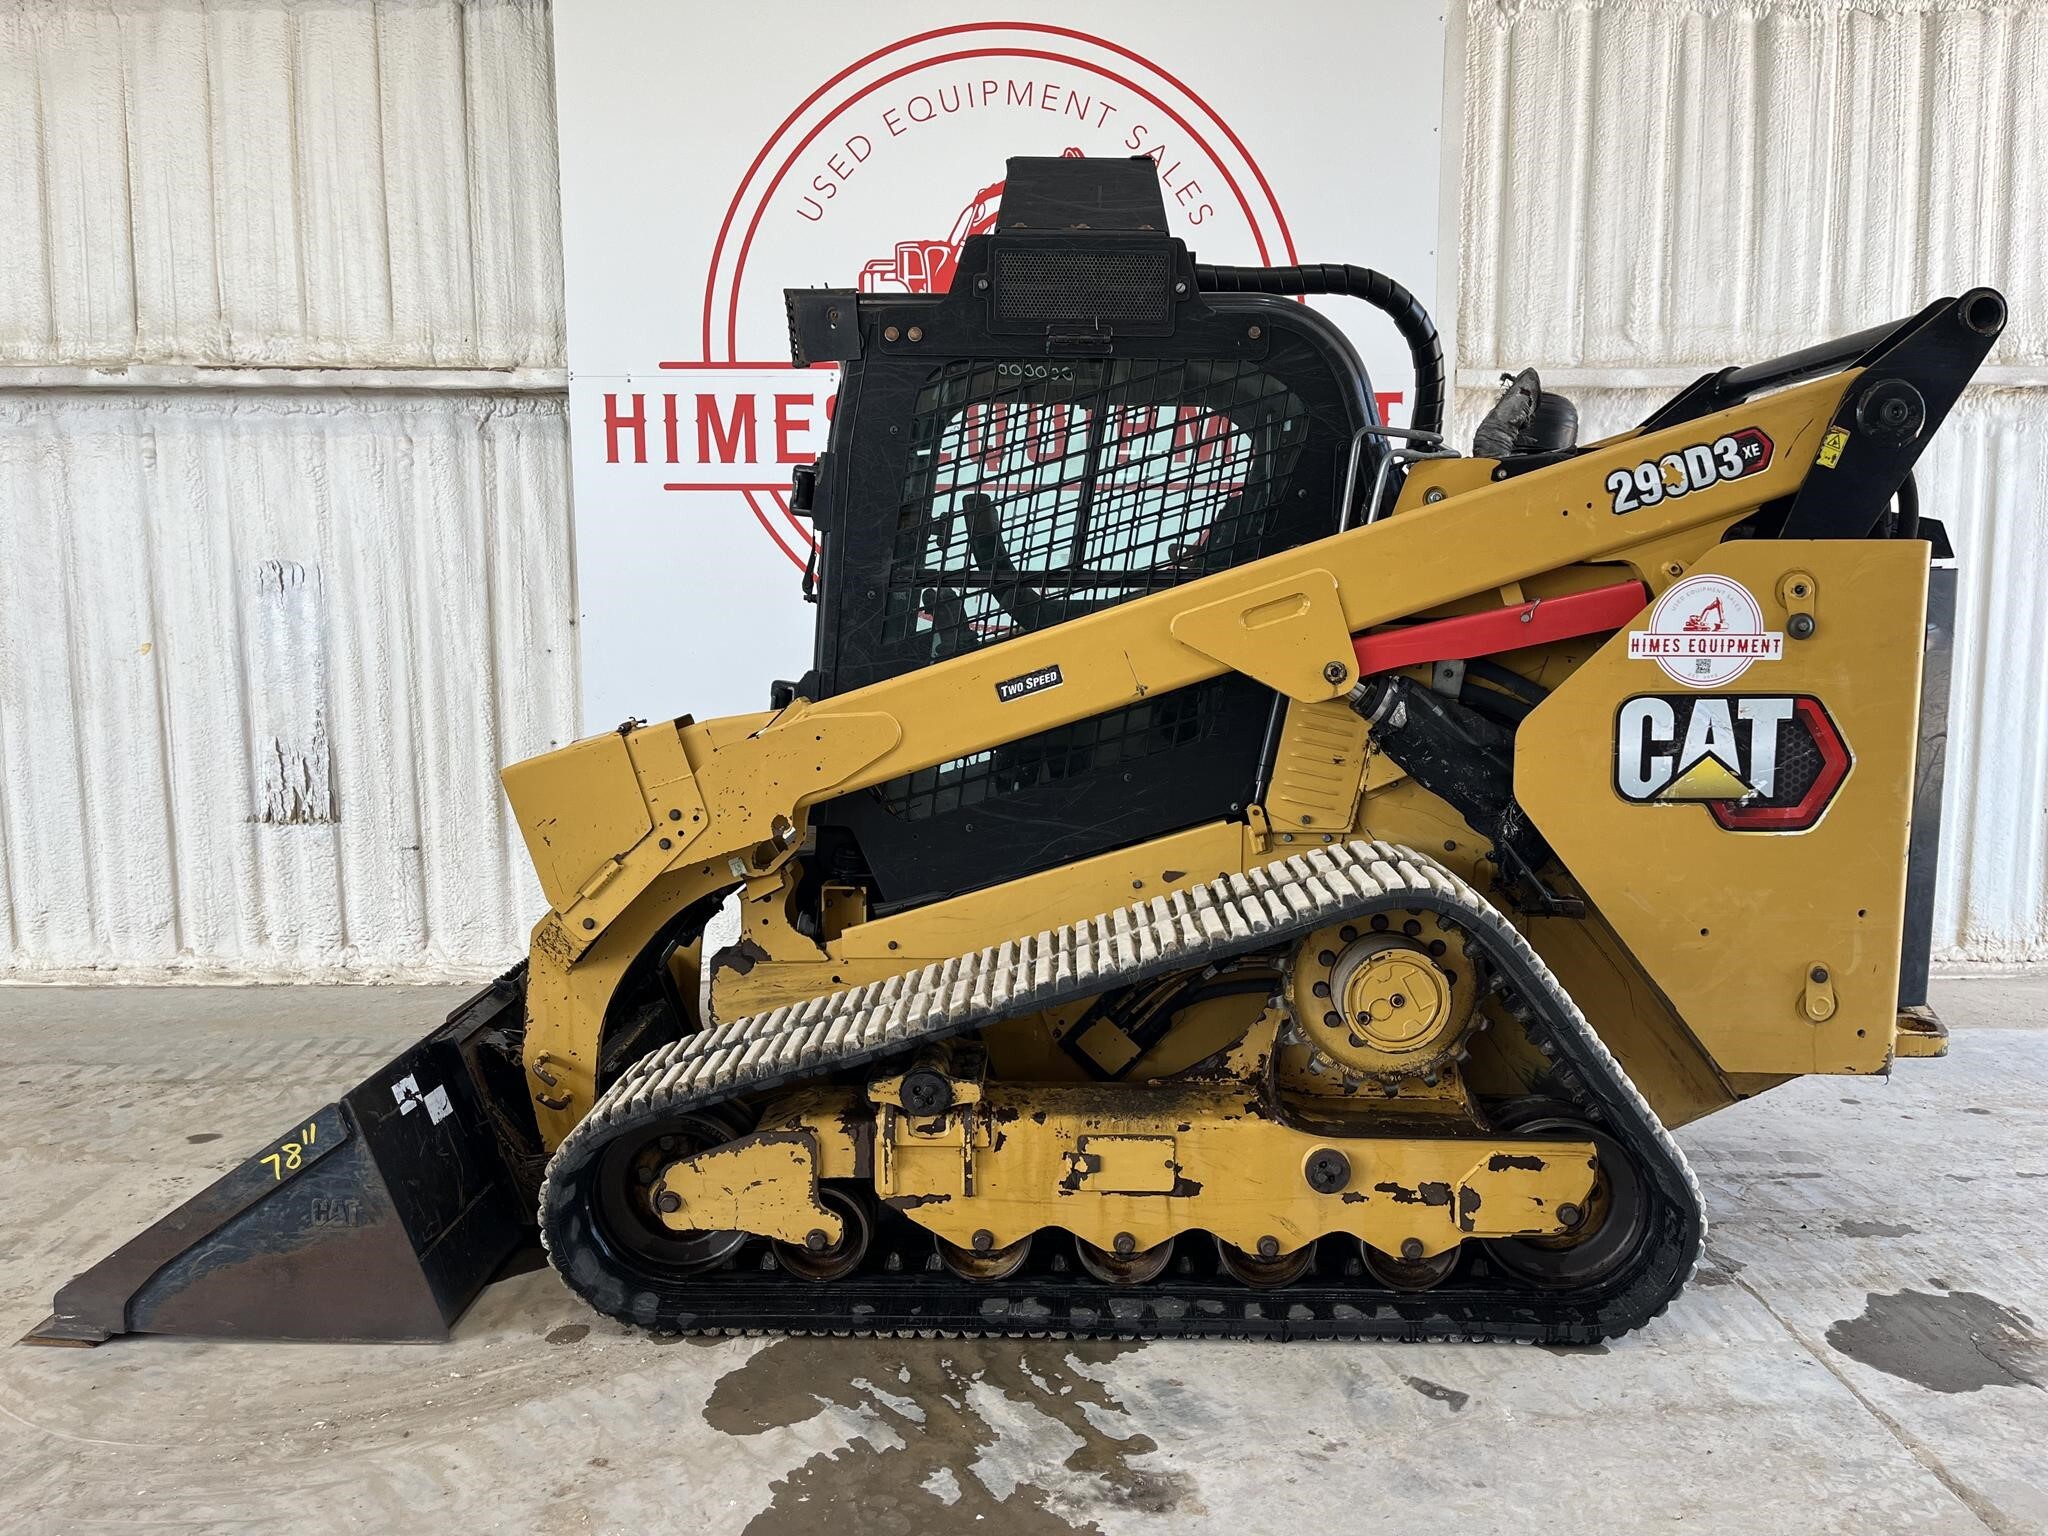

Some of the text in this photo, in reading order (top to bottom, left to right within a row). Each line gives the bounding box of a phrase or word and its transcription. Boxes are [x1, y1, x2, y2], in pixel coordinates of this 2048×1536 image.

[797, 79, 1214, 226] USED EQUIPMENT SALES
[603, 393, 837, 463] HIME
[1742, 443, 1761, 460] XE
[1631, 638, 1782, 654] HIMES EQUIPMENT
[1618, 697, 1794, 799] CAT
[310, 1198, 360, 1228] CAT
